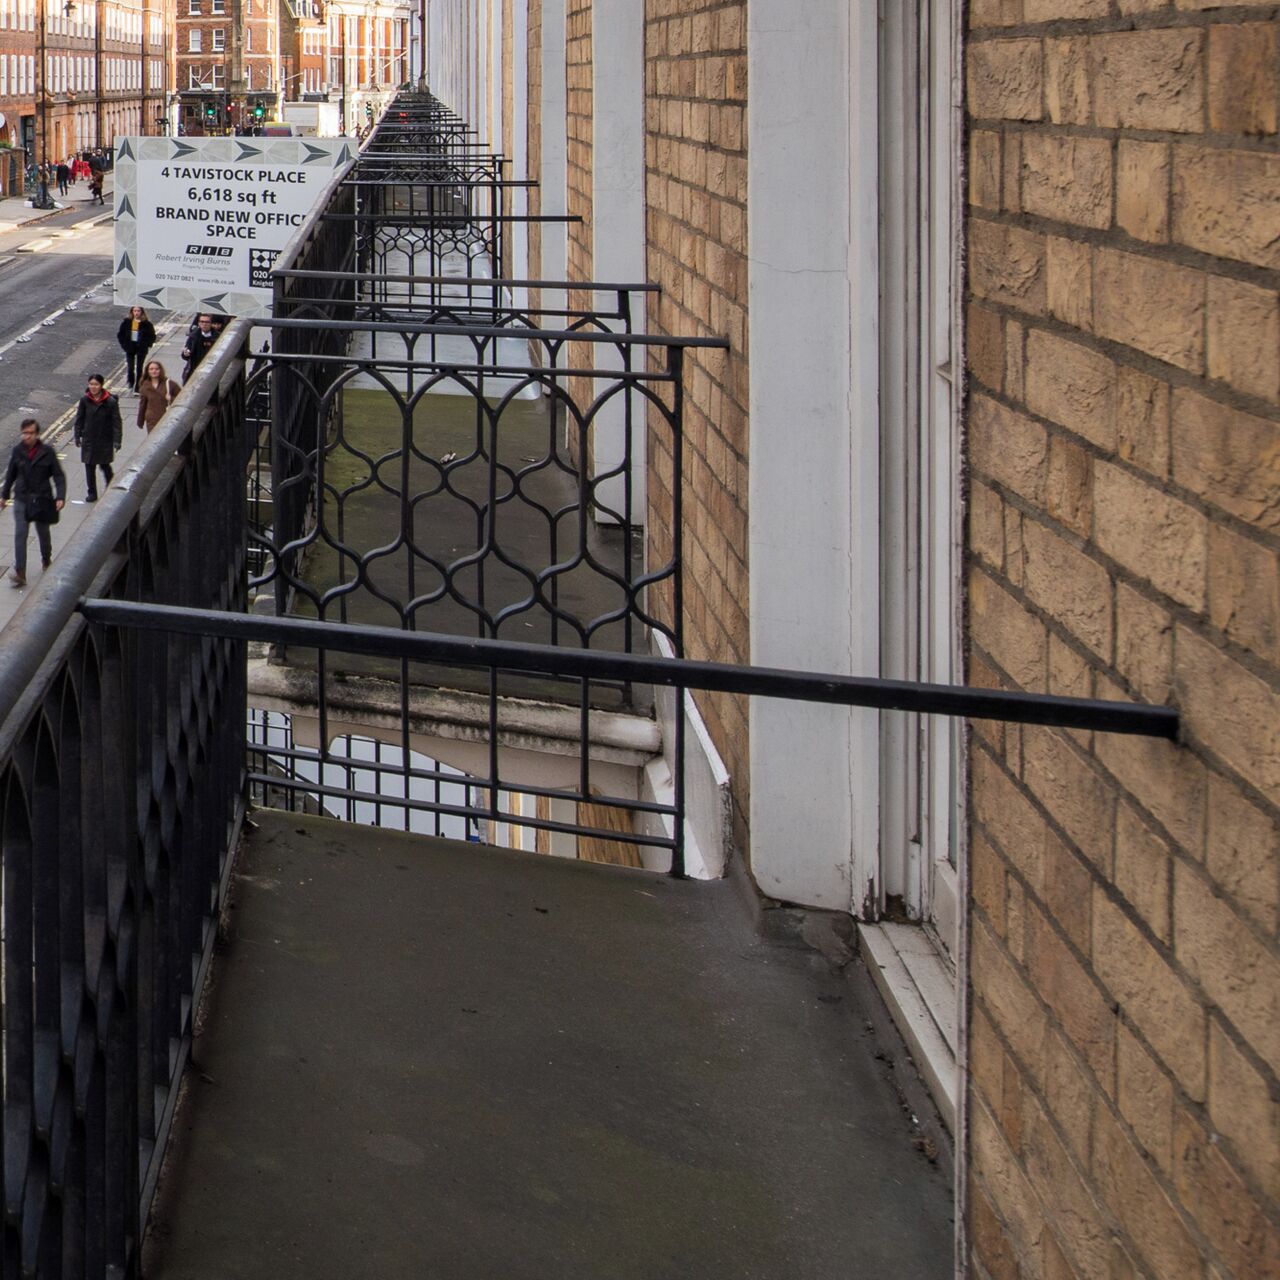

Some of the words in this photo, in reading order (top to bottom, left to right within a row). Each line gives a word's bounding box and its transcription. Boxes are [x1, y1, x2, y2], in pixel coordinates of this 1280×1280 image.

[161, 167, 170, 178] 4
[173, 167, 254, 181] TAVISTOCK
[258, 170, 306, 183] PLACE
[188, 187, 233, 202] 6,618
[237, 192, 257, 207] sq
[261, 189, 277, 204] ft
[156, 206, 210, 221] BRAND
[214, 210, 251, 224] NEW
[206, 224, 257, 239] SPACE
[187, 245, 232, 256] RIB
[155, 253, 181, 263] Robert
[183, 256, 205, 266] Irving
[206, 258, 231, 266] Burns
[253, 270, 268, 279] 020
